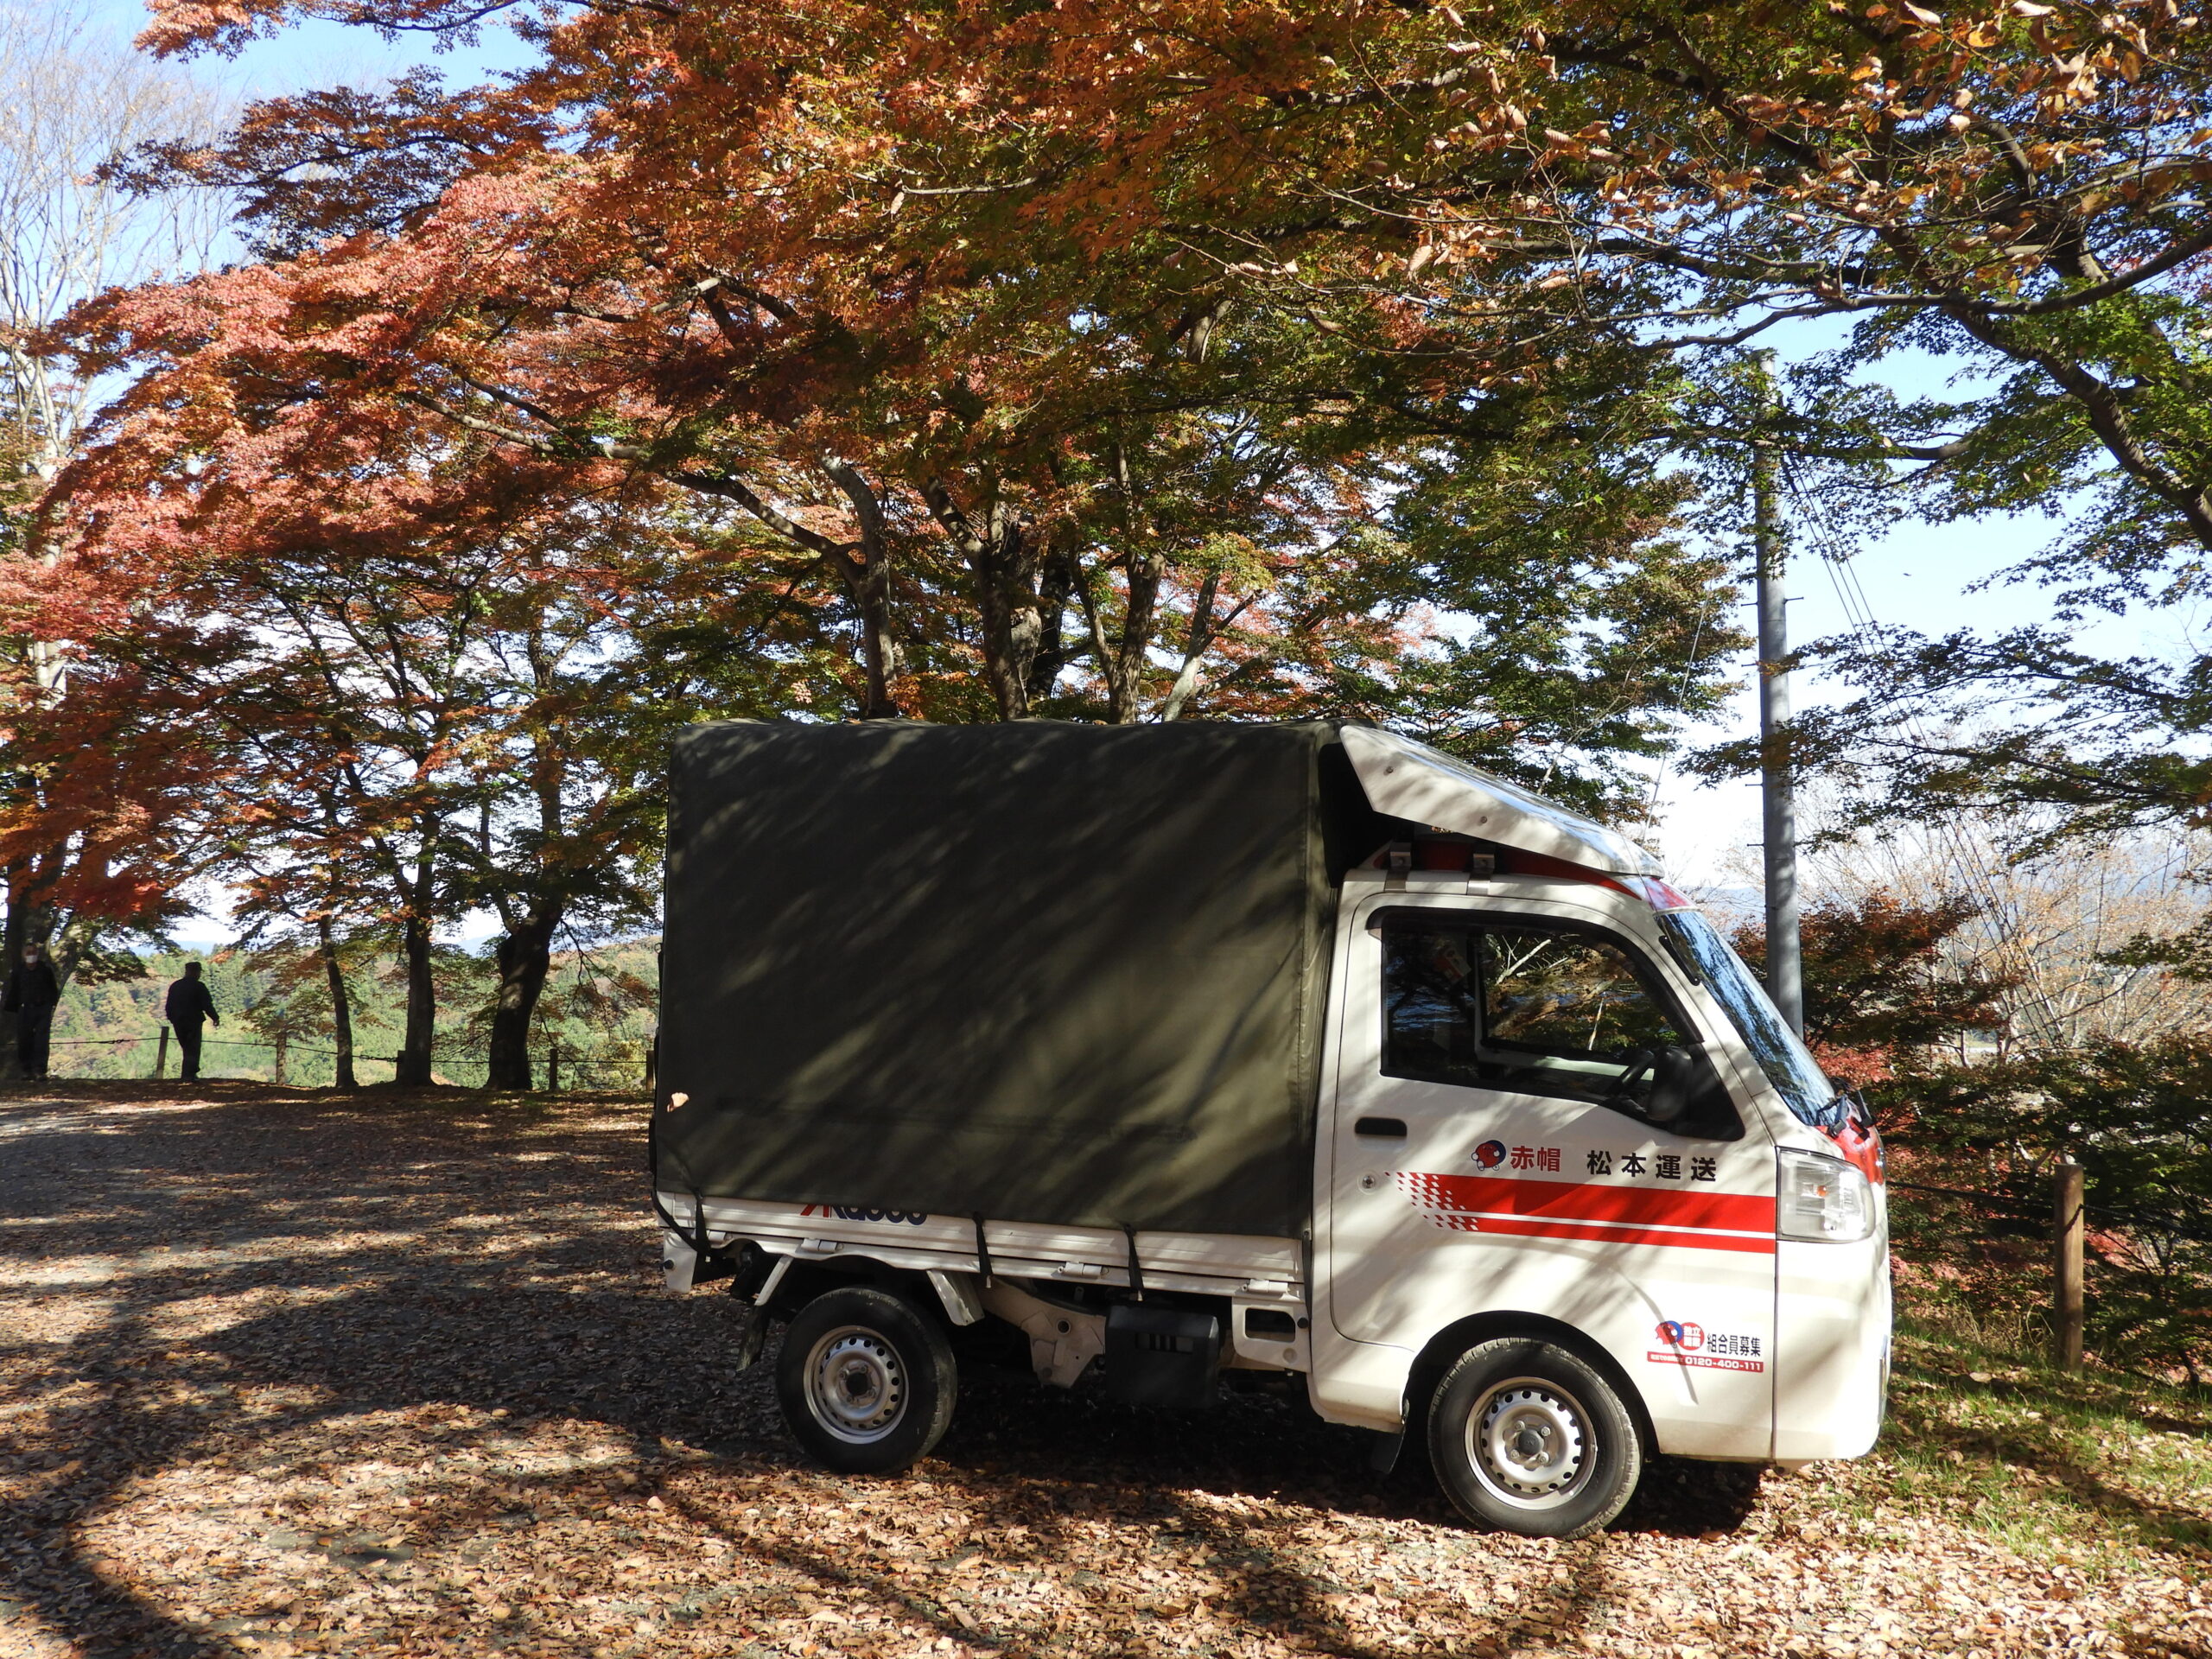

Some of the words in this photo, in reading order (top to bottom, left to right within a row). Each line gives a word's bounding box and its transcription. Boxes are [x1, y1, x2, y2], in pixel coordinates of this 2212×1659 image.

[1510, 1145, 1560, 1172] 赤帽
[1586, 1149, 1717, 1182] 松本運送
[1707, 1333, 1761, 1357] 組合員募集
[1685, 1357, 1761, 1371] 0120-400-111
